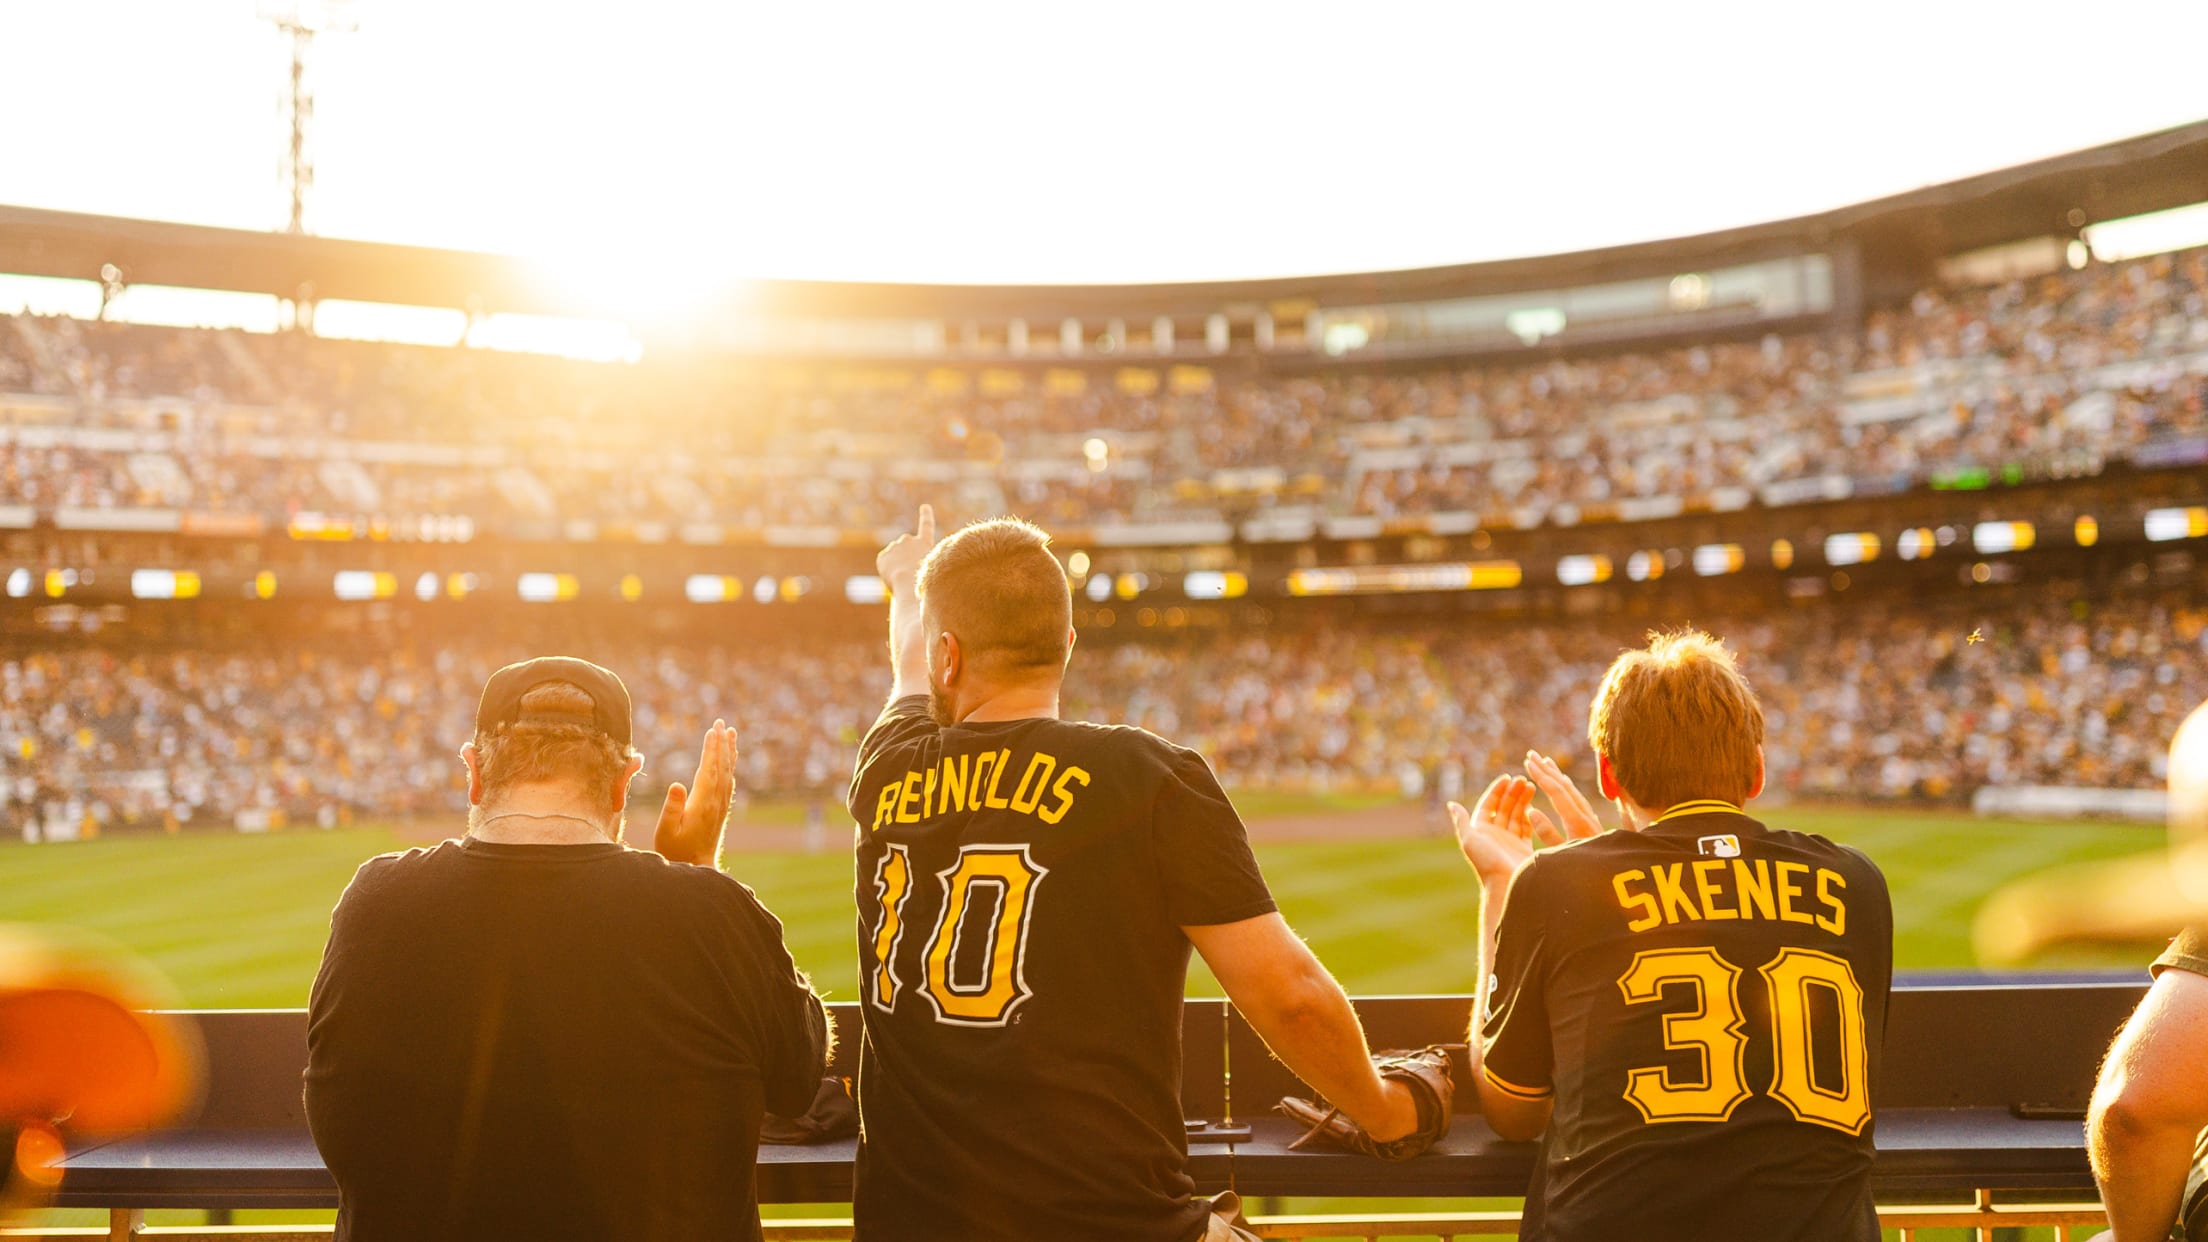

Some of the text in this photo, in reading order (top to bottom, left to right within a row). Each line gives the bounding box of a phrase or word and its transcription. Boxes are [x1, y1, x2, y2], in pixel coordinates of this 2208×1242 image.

[872, 748, 1091, 831] REYNOLDS
[872, 842, 1049, 1028] 10
[1612, 859, 1846, 936] SKENES
[1616, 946, 1872, 1136] 30
